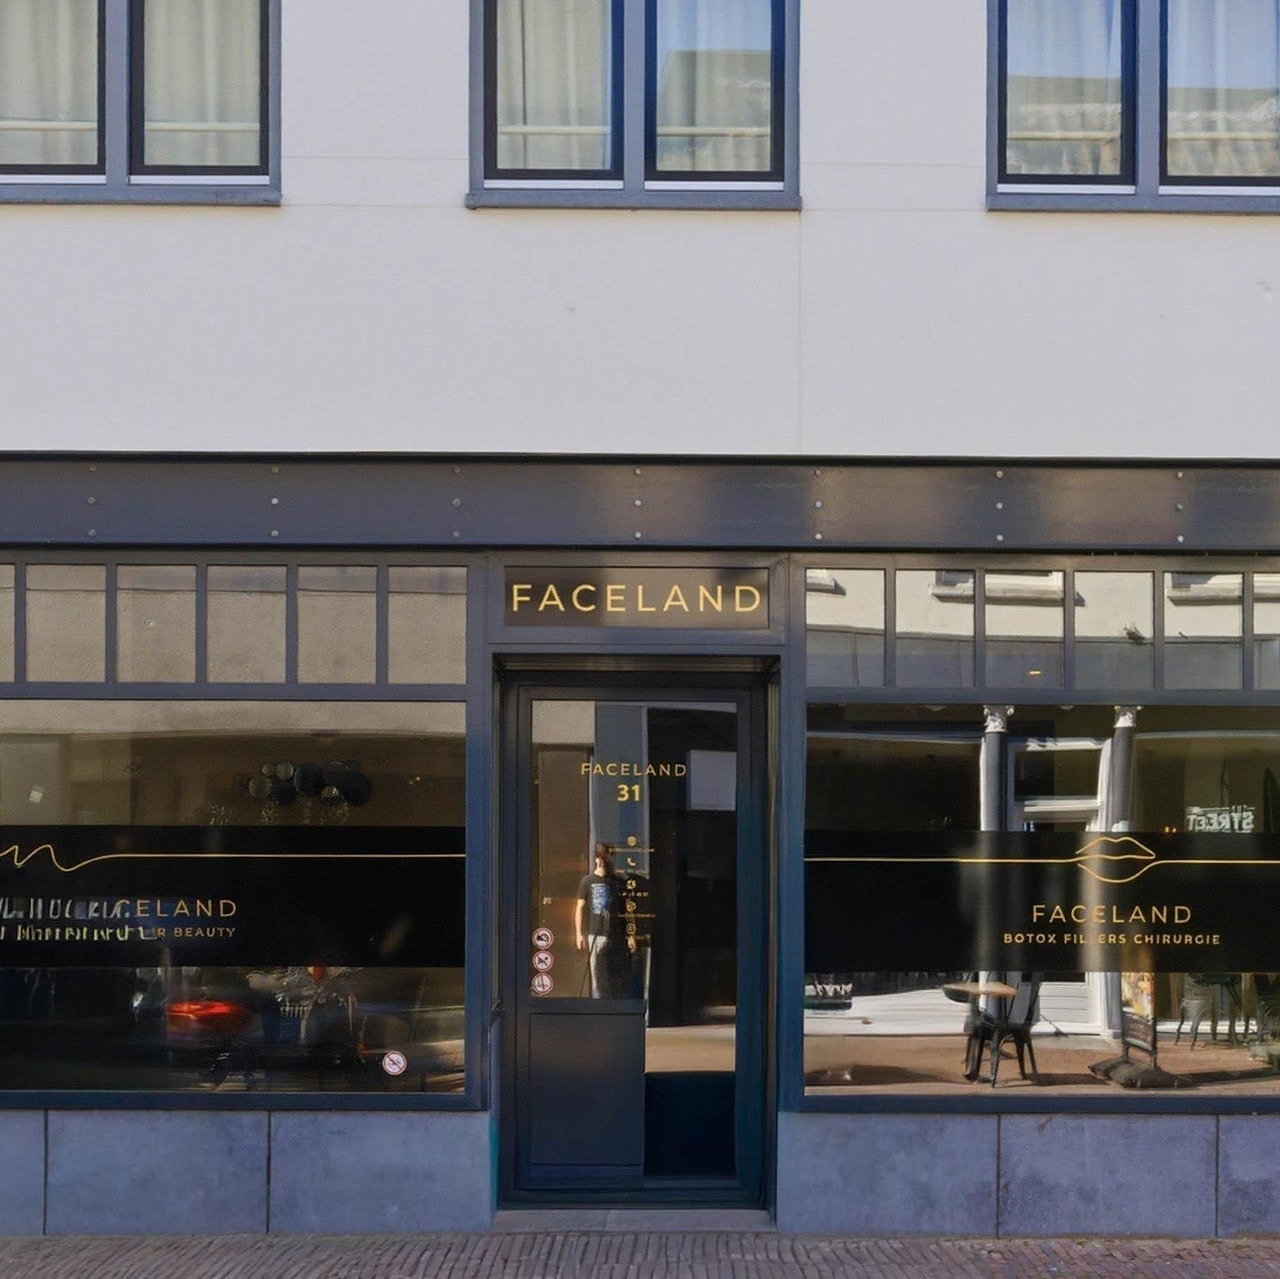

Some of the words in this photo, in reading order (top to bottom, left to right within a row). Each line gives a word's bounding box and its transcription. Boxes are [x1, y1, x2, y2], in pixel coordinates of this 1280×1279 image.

[512, 584, 761, 612] FACELAND
[580, 762, 687, 777] FACELAND
[617, 784, 640, 802] 31
[1031, 905, 1192, 923] FACELAND
[173, 927, 236, 938] BEAUTY
[1003, 933, 1057, 944] BOTOX
[1064, 934, 1126, 944] FILERS
[1133, 934, 1221, 945] CHIRURGIE
